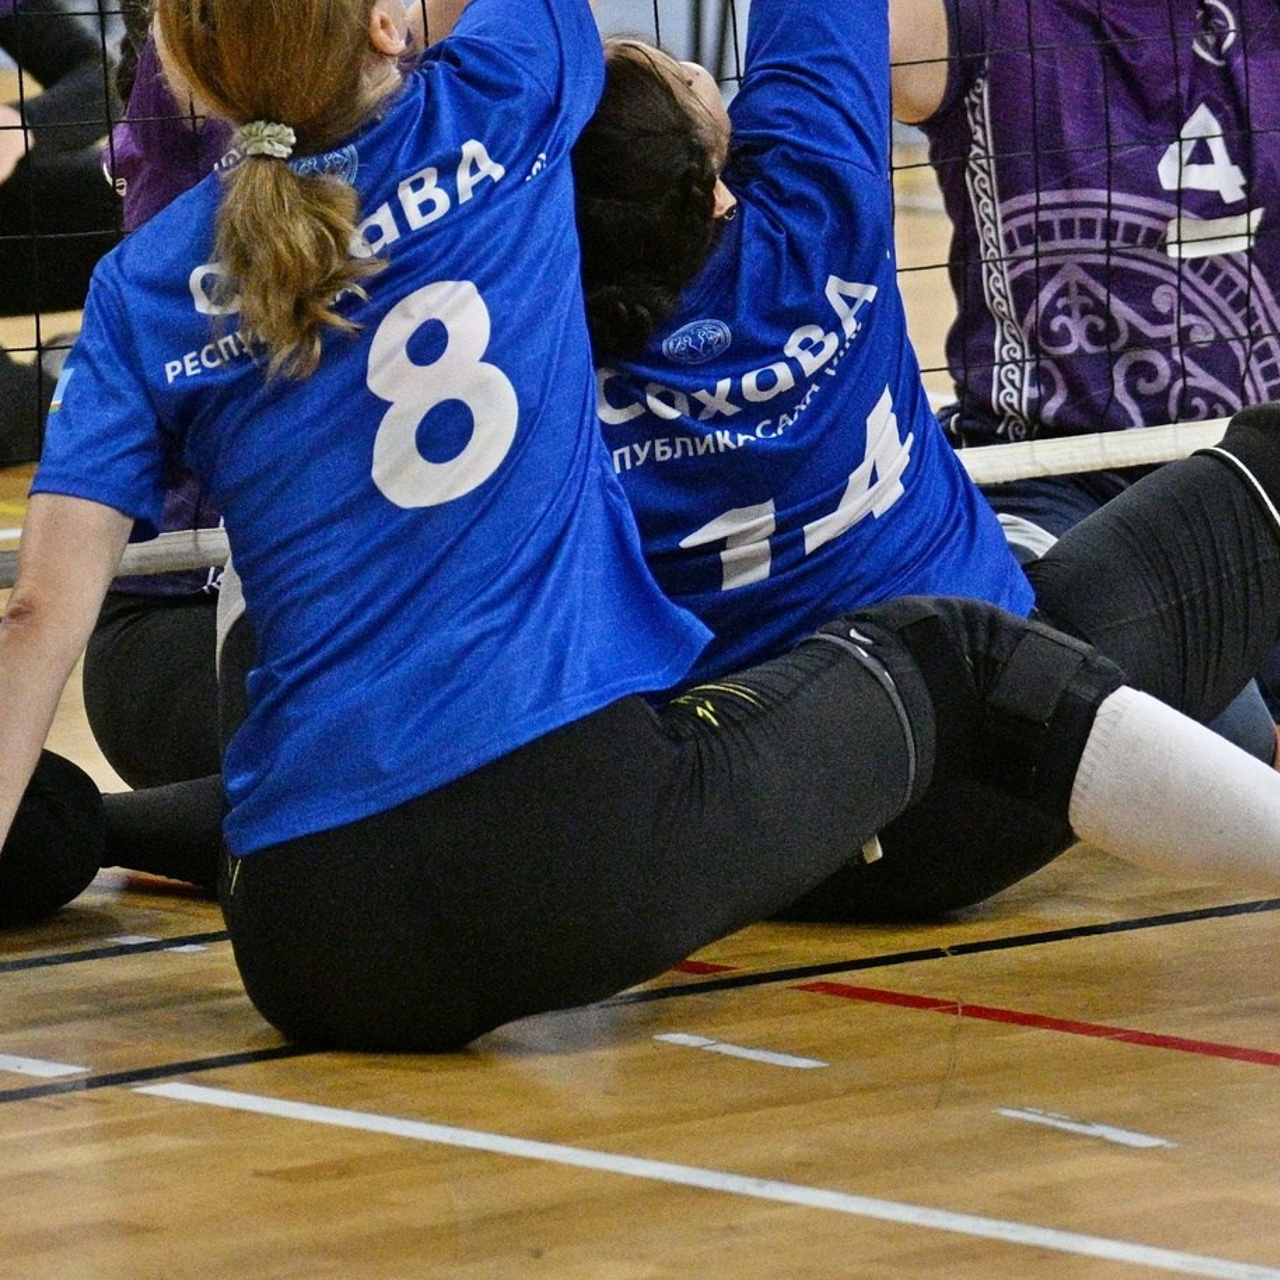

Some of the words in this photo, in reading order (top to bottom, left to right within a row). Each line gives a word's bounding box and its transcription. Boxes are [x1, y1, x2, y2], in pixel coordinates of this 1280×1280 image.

[1157, 102, 1248, 205] 4
[366, 280, 519, 509] 8
[679, 384, 914, 591] 14
